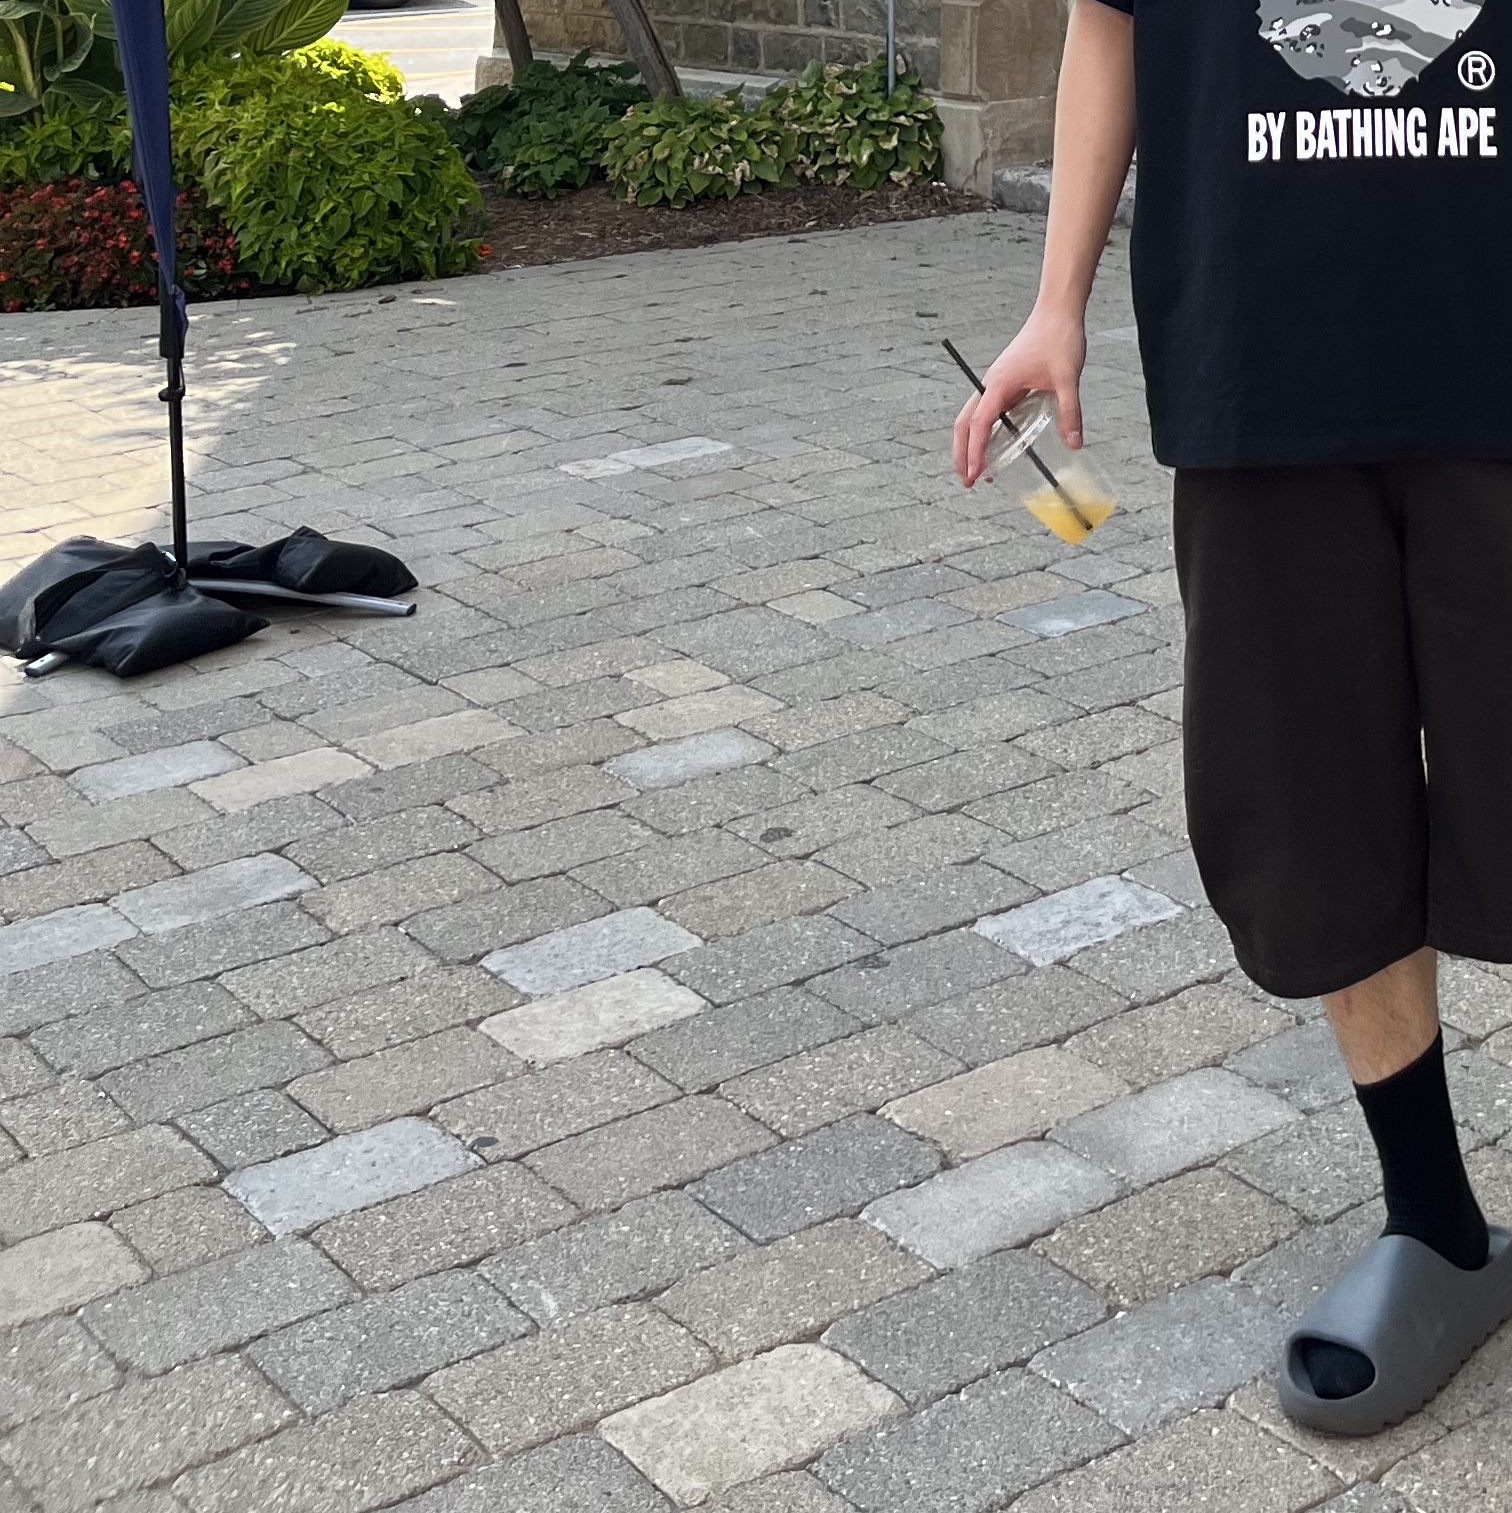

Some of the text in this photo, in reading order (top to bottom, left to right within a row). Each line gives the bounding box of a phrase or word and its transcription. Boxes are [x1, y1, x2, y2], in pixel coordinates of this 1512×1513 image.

[1247, 107, 1498, 162] BY BATHING APE
